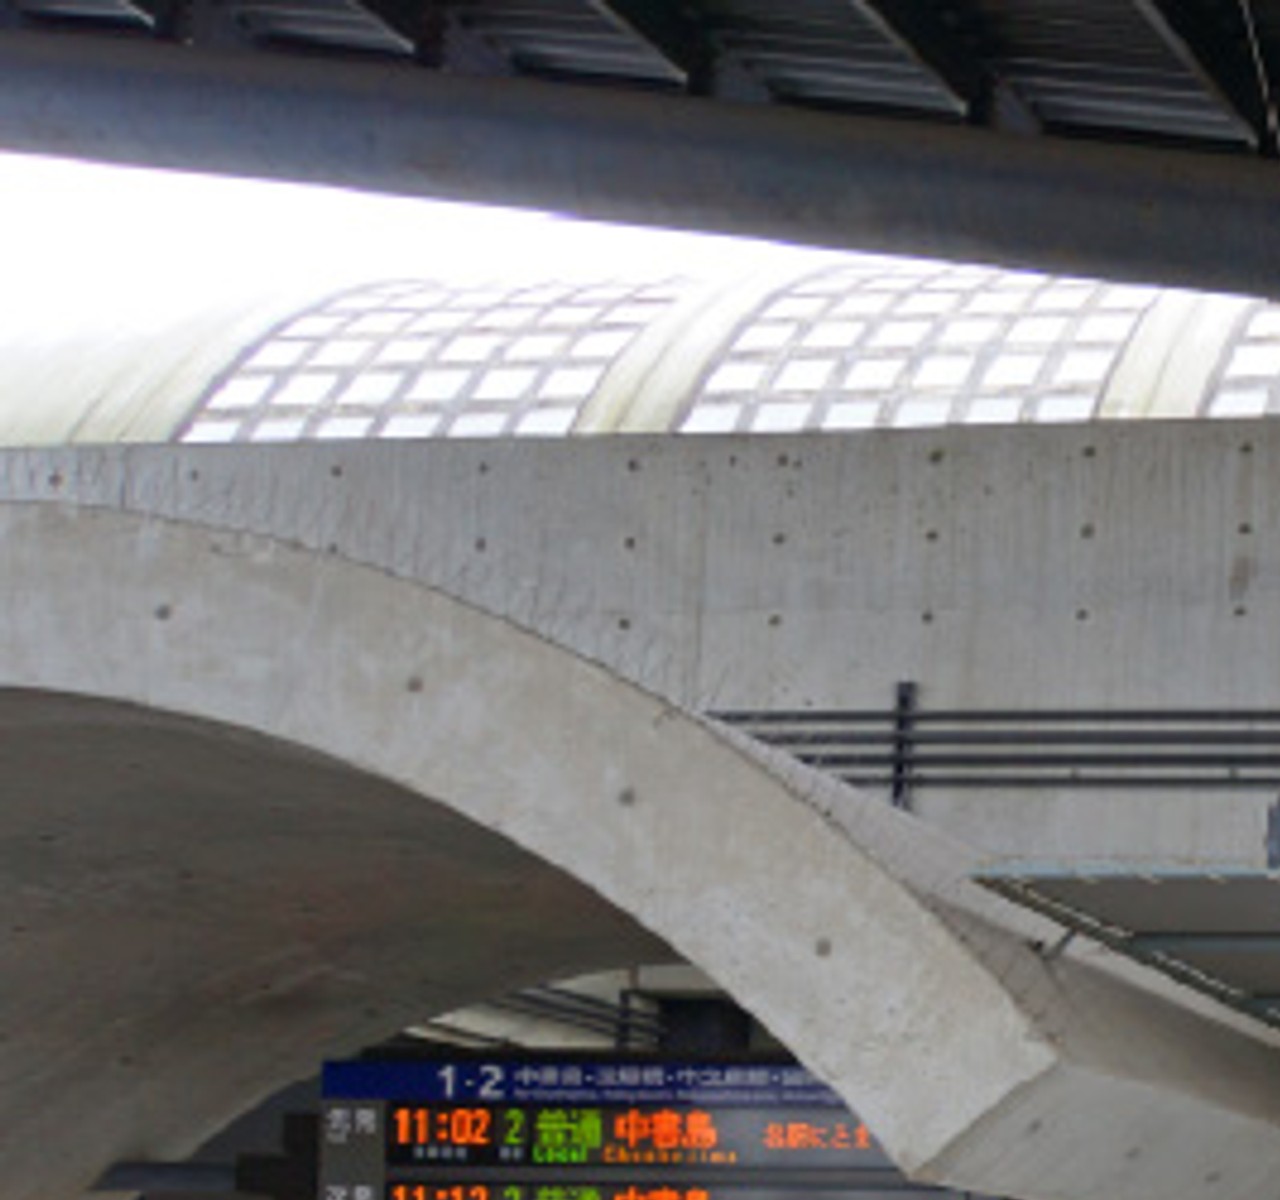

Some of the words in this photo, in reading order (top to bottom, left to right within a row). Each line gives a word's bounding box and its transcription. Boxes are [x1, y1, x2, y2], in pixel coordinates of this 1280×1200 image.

[394, 1109, 491, 1144] 11:02
[504, 1109, 525, 1144] 2
[536, 1108, 601, 1147] 普通
[614, 1109, 717, 1148] 中書島
